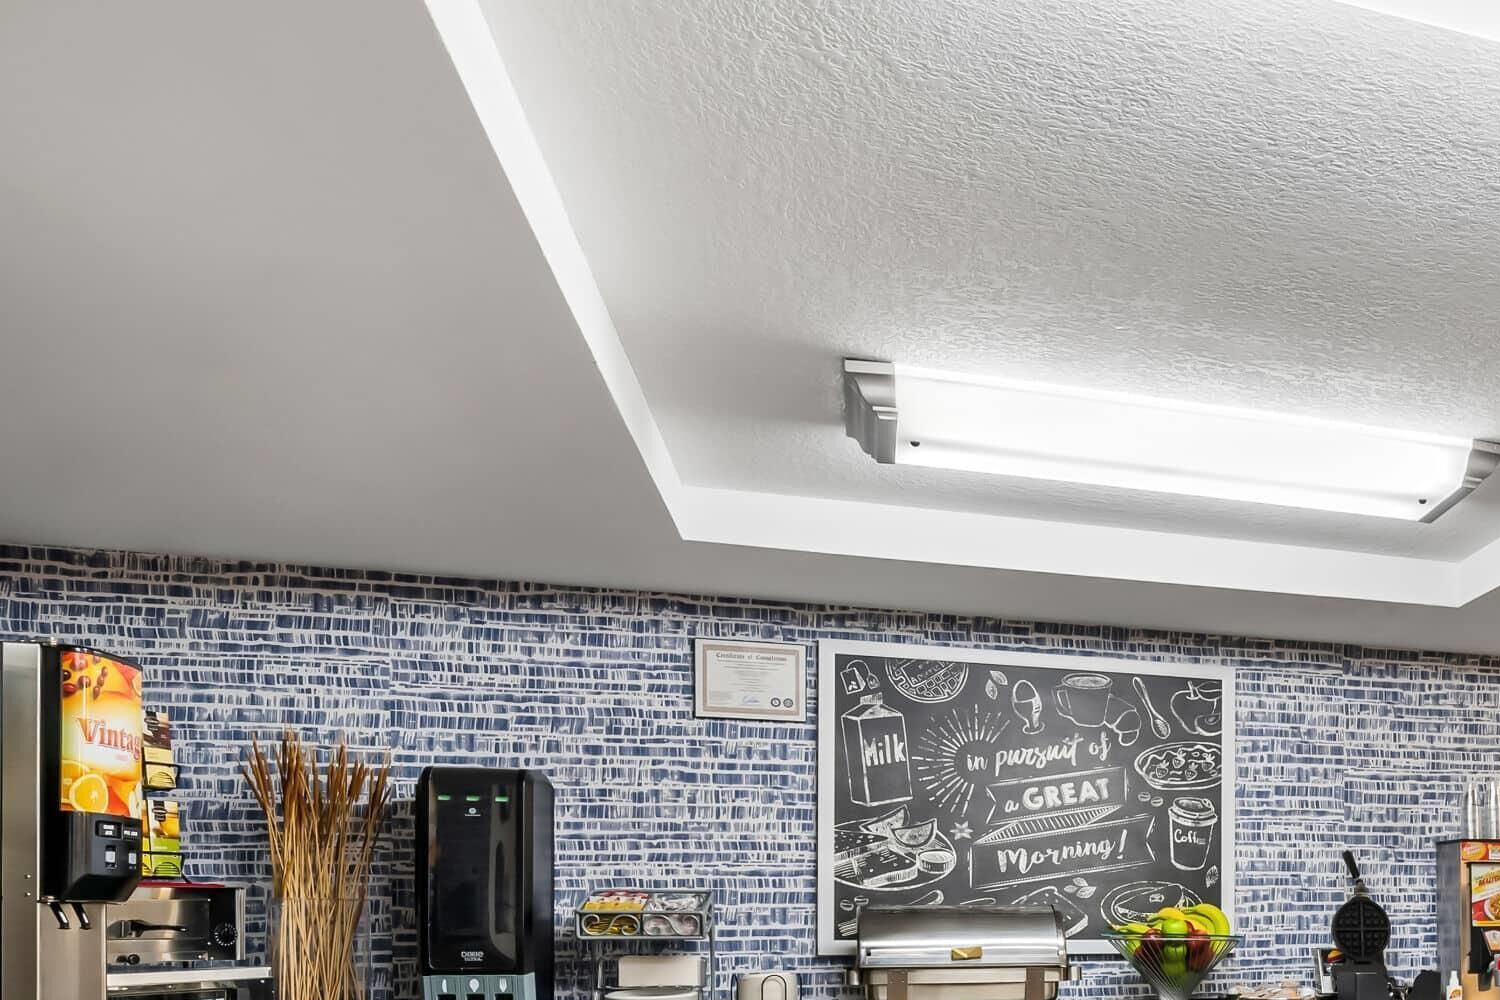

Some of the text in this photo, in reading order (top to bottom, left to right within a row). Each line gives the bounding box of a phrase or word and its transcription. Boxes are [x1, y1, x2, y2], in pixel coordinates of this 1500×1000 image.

[863, 733, 906, 768] Milk
[966, 731, 1112, 777] in pursuit of
[1004, 777, 1110, 813] a GREAT
[997, 828, 1128, 874] Morning!
